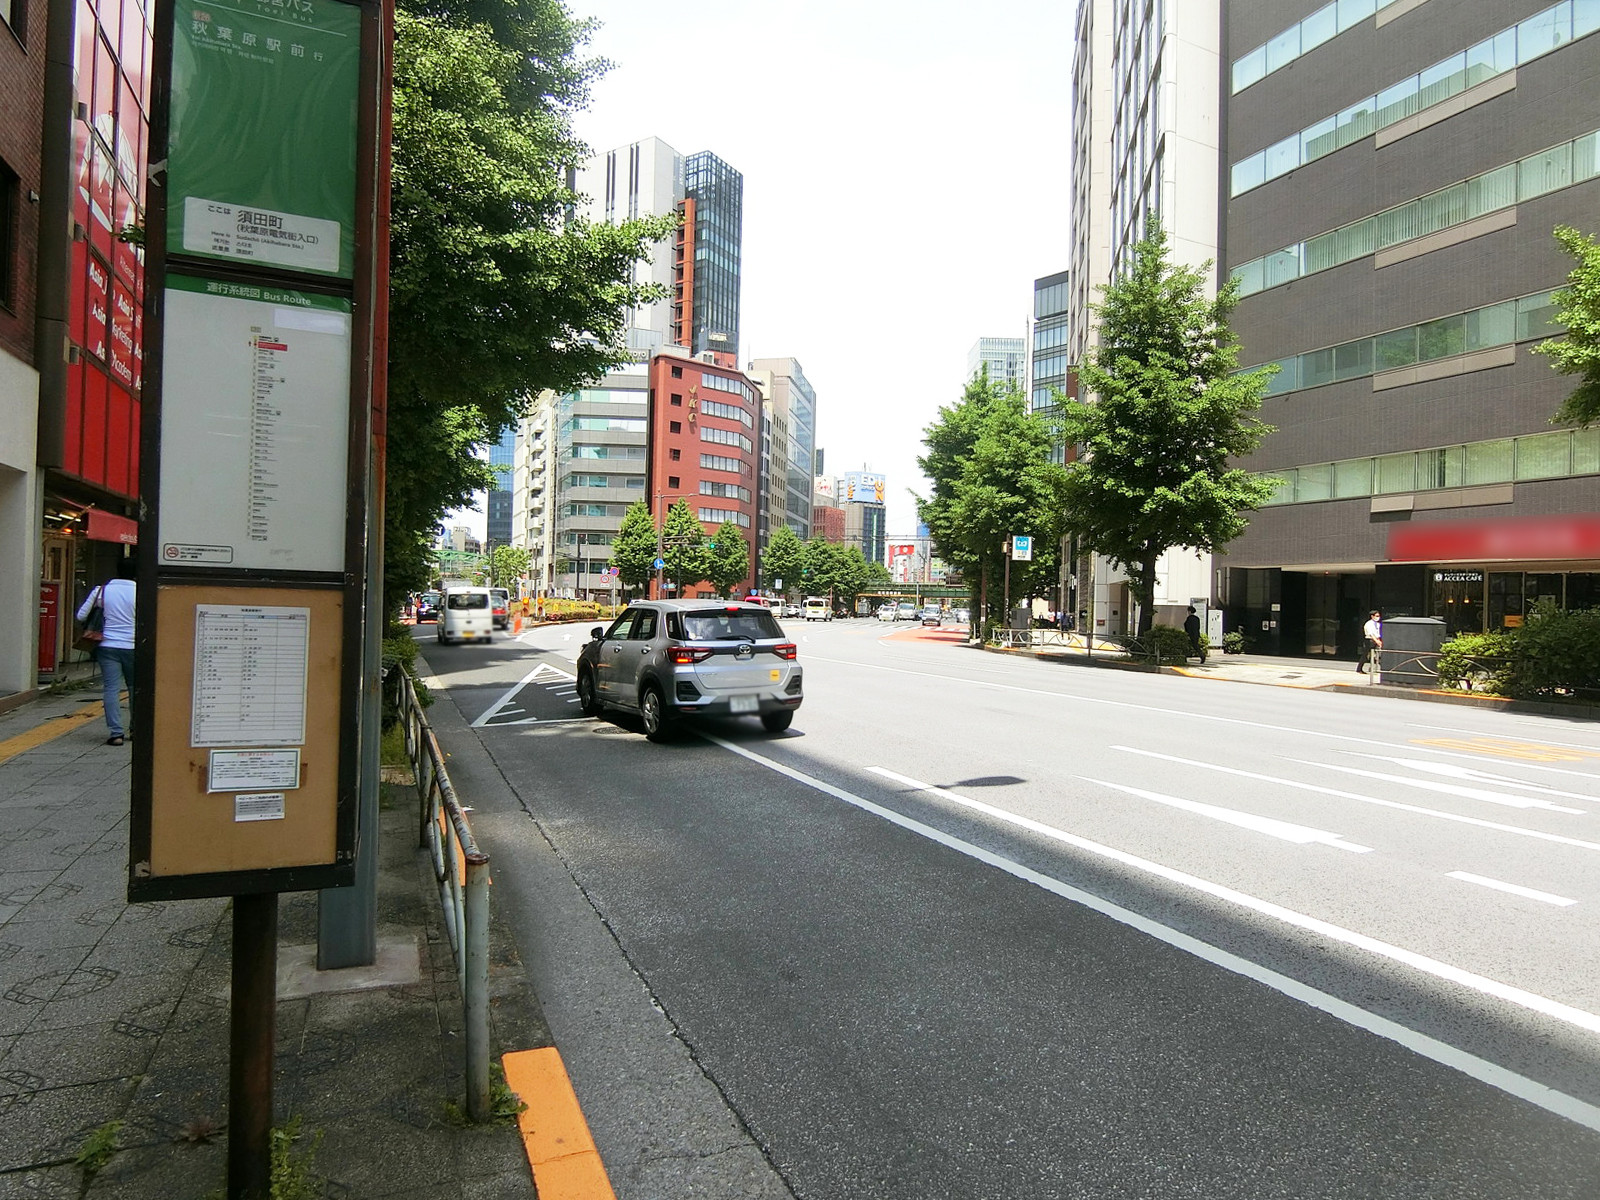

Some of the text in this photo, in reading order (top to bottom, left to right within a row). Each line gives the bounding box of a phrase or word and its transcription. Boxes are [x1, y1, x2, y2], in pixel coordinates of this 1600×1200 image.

[207, 204, 284, 230] ここは 須田町
[236, 224, 319, 245] (秋葉原電気街入口)
[89, 262, 103, 289] Asia
[118, 293, 131, 317] Asia
[206, 281, 312, 307] 運行系統図 Bus Route
[92, 303, 106, 326] Asia
